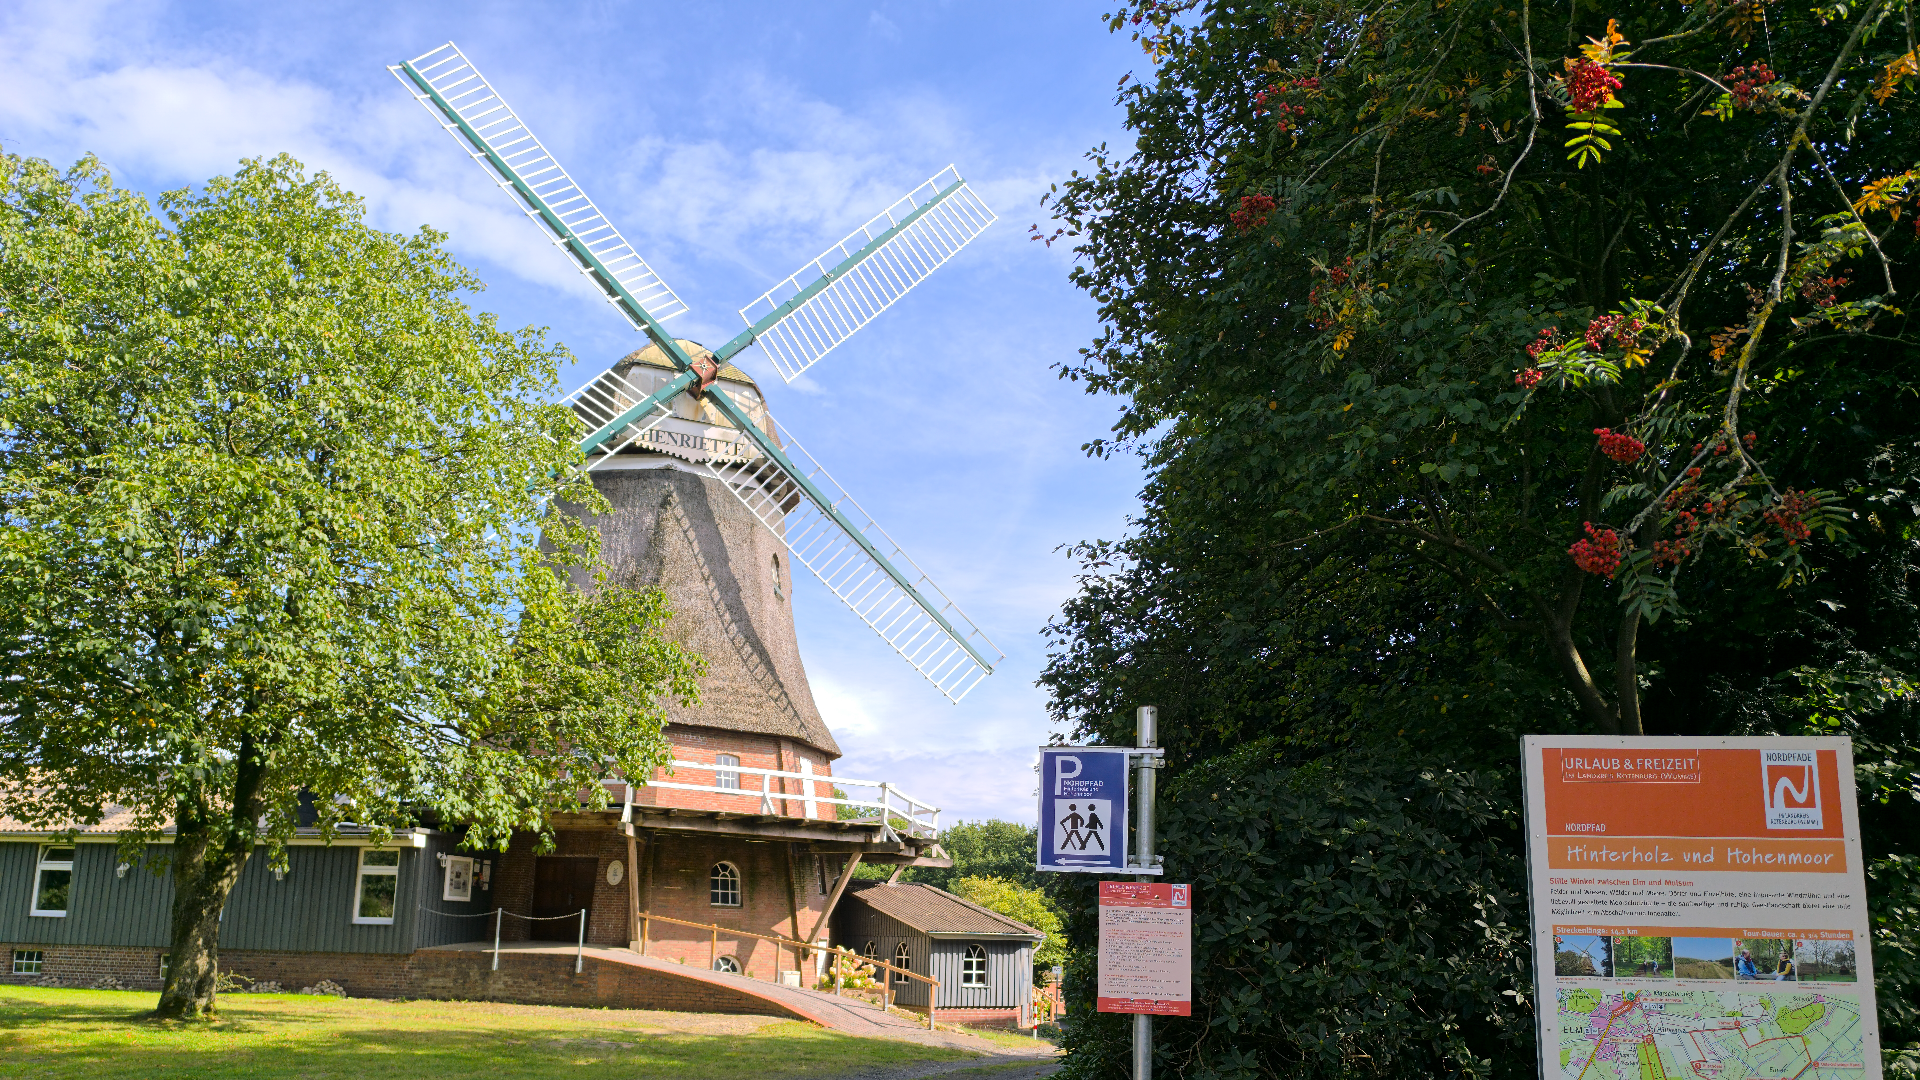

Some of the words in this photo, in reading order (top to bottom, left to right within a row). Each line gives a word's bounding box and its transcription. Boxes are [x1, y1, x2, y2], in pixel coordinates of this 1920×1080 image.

[640, 428, 745, 456] HENRIETTE
[1766, 753, 1812, 762] NORDPFADE
[1565, 758, 1620, 770] URLAUB
[1624, 759, 1634, 770] &
[1637, 758, 1695, 770] FREIZEIT
[1055, 756, 1082, 796] P
[1566, 823, 1606, 832] NORDPFAD
[1568, 844, 1674, 863] Hinterholz
[1683, 847, 1714, 864] und
[1727, 848, 1834, 864] Hohenmoor
[1597, 878, 1630, 886] zwischen
[1556, 927, 1608, 935] Streckenlänge:
[1743, 930, 1785, 938] Tour-Dauer:
